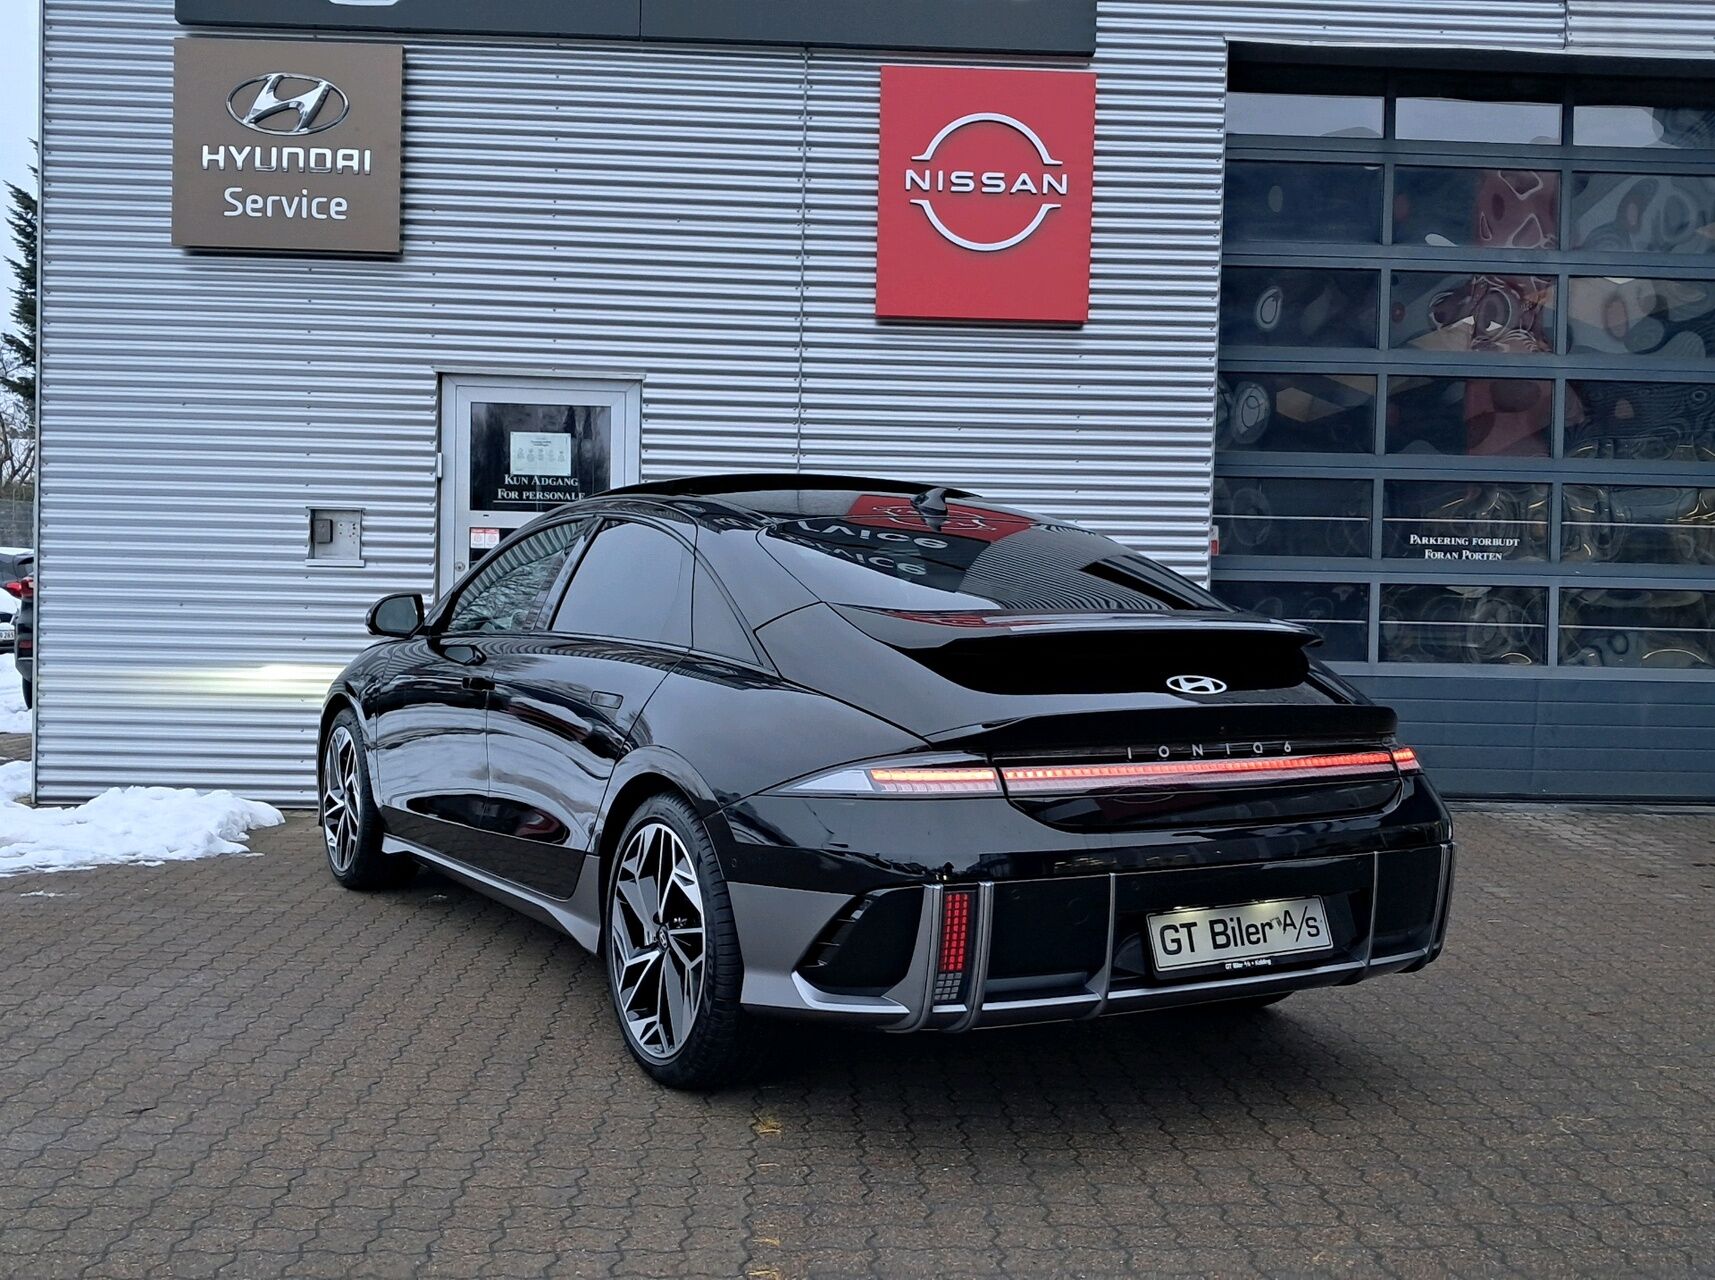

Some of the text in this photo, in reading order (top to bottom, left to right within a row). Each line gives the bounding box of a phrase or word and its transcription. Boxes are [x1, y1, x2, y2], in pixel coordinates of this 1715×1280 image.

[202, 145, 372, 175] HYUNDAI
[905, 169, 1068, 195] NISSAN
[223, 187, 348, 220] Service
[504, 474, 579, 486] KUN ADGANG
[497, 488, 519, 499] FOR
[1409, 534, 1520, 547] PARKERING FORBUDT
[1424, 549, 1502, 560] FORAN PORTEN
[1159, 921, 1198, 956] GT
[1208, 916, 1274, 950] Biler
